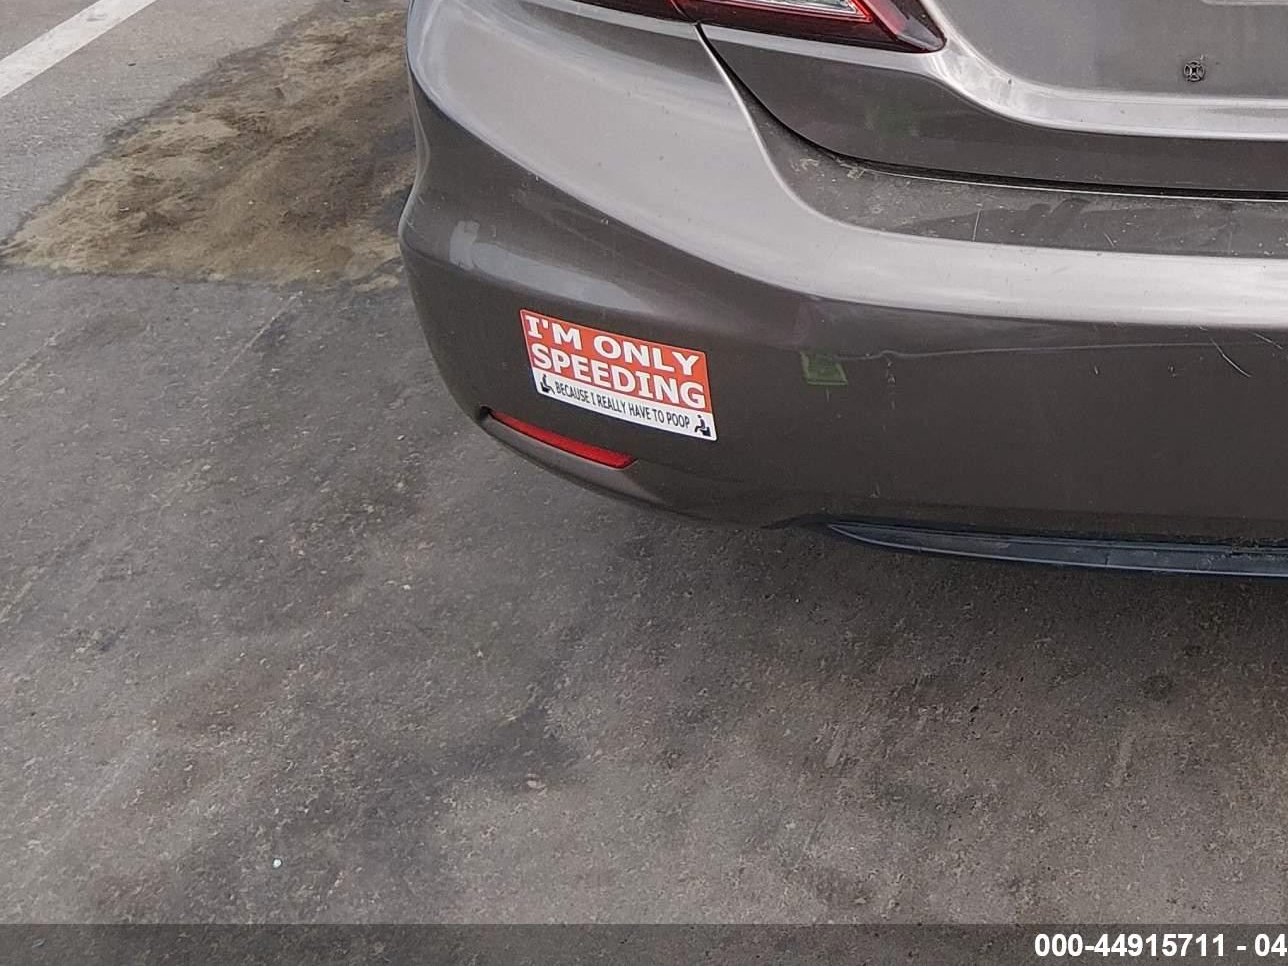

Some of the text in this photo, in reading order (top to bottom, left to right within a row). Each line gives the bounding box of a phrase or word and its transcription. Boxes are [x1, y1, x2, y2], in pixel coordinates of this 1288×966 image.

[525, 315, 700, 376] I'M ONLY
[531, 342, 707, 409] SPEEDING
[555, 381, 591, 404] BECAUSE
[596, 394, 627, 414] REALLY
[628, 402, 652, 421] HAVE
[651, 408, 665, 424] TO
[667, 412, 691, 429] POOP
